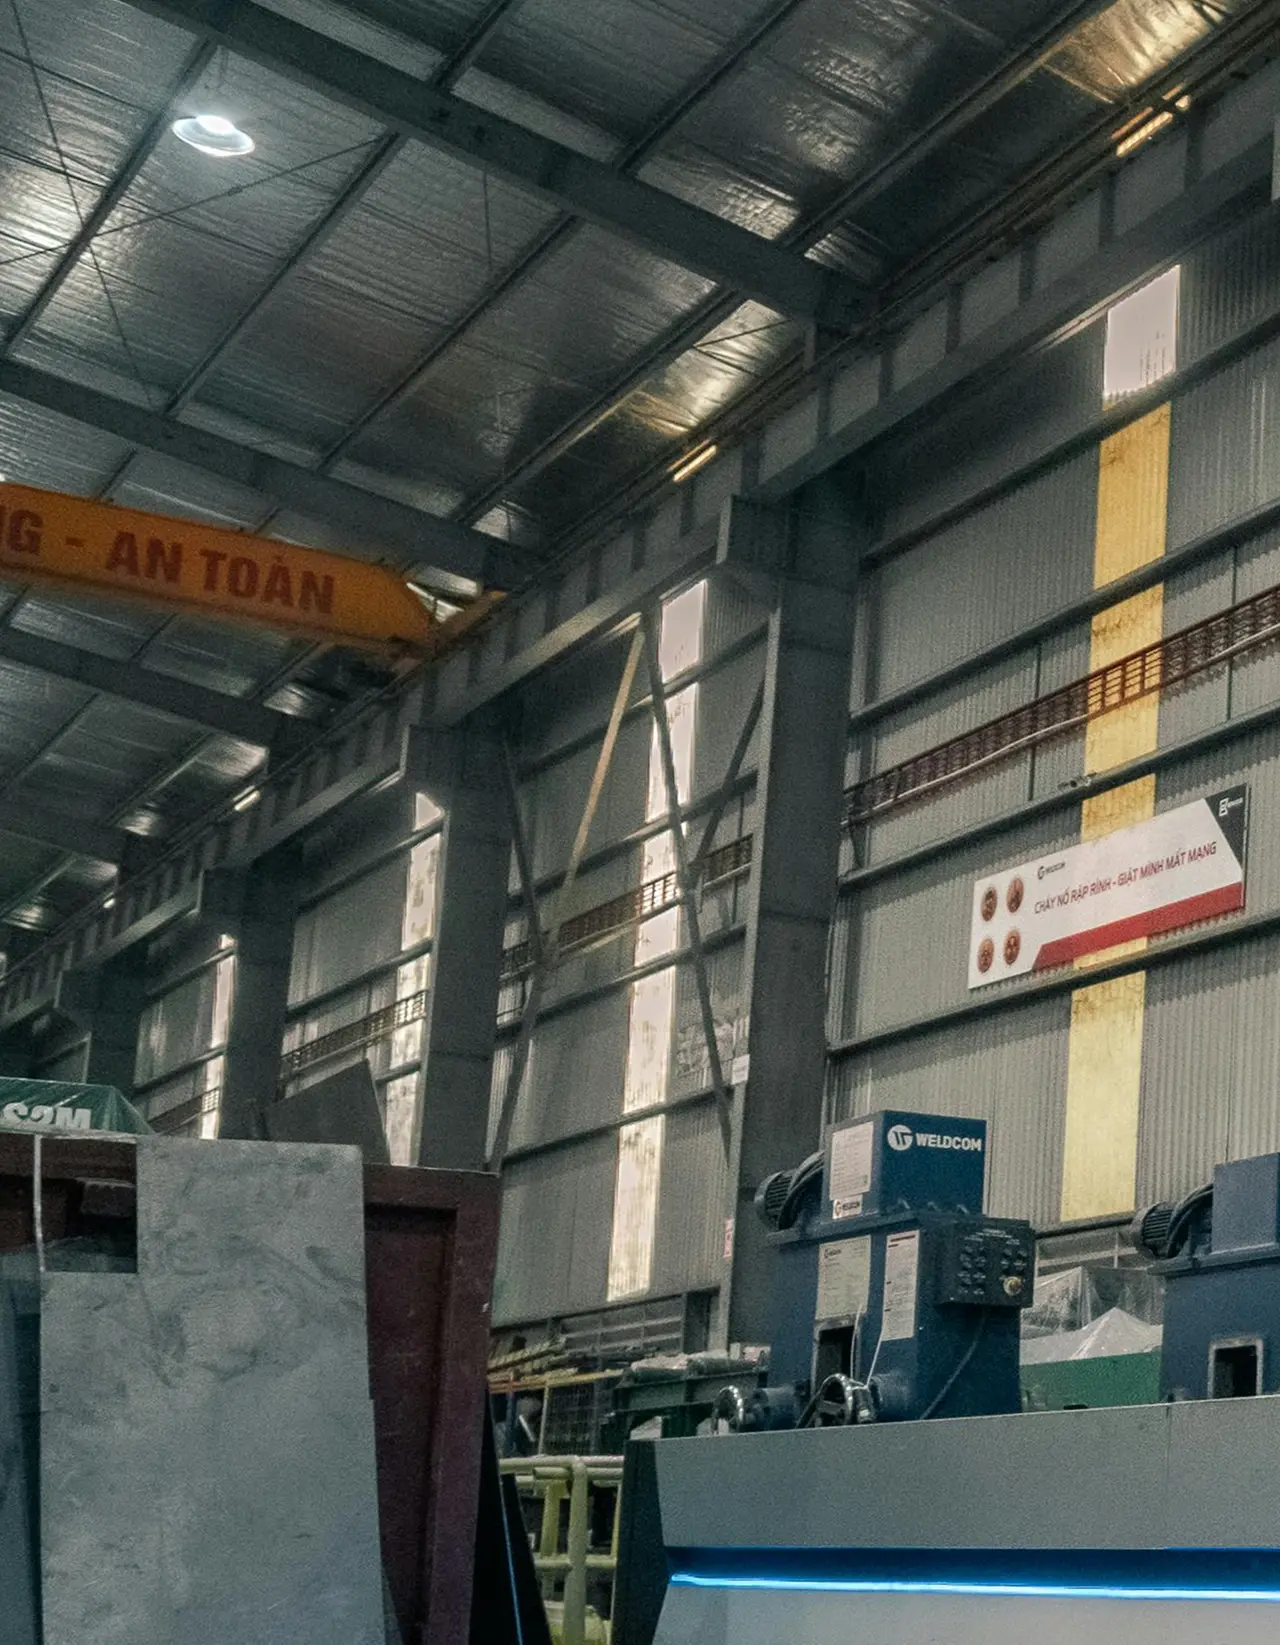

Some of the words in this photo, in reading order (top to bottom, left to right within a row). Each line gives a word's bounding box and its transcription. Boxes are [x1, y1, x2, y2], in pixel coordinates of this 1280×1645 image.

[0, 506, 43, 556] G
[106, 530, 184, 584] AN
[200, 548, 334, 614] TOÀN
[1034, 895, 1056, 914] CHÁY
[915, 1132, 982, 1152] WELDCOM
